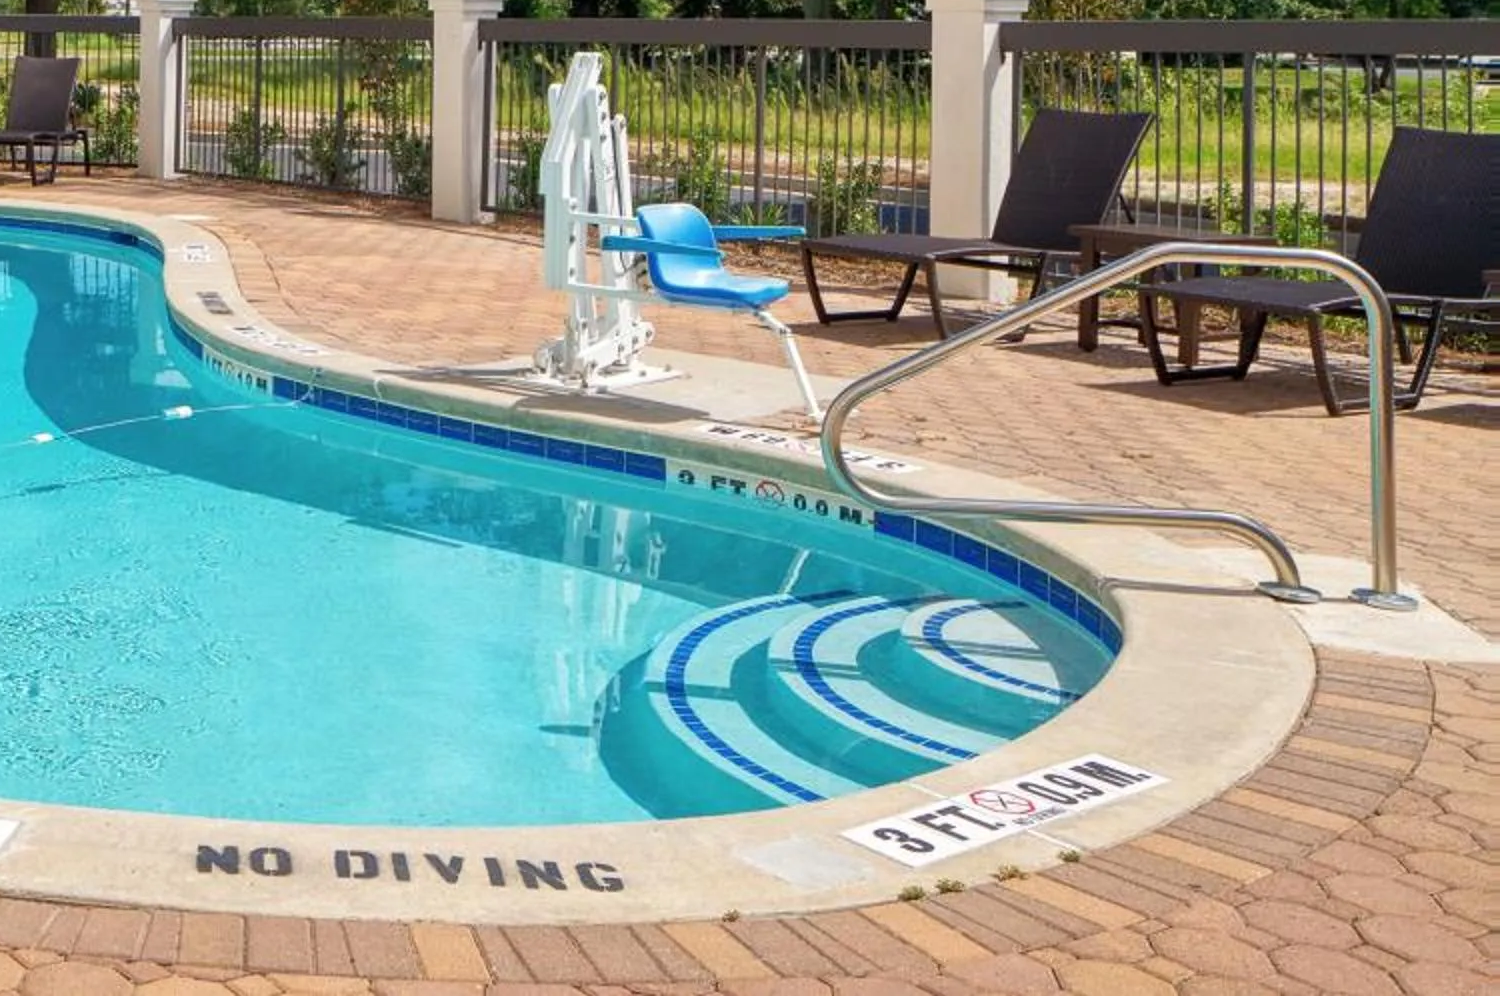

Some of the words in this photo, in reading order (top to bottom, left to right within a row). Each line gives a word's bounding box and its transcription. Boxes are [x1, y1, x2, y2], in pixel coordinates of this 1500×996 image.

[872, 826, 936, 854] 3
[910, 805, 1005, 842] FT.
[1016, 773, 1105, 805] 0.9
[1070, 760, 1153, 789] M.
[195, 844, 294, 878] NO
[333, 848, 625, 893] DIVING
